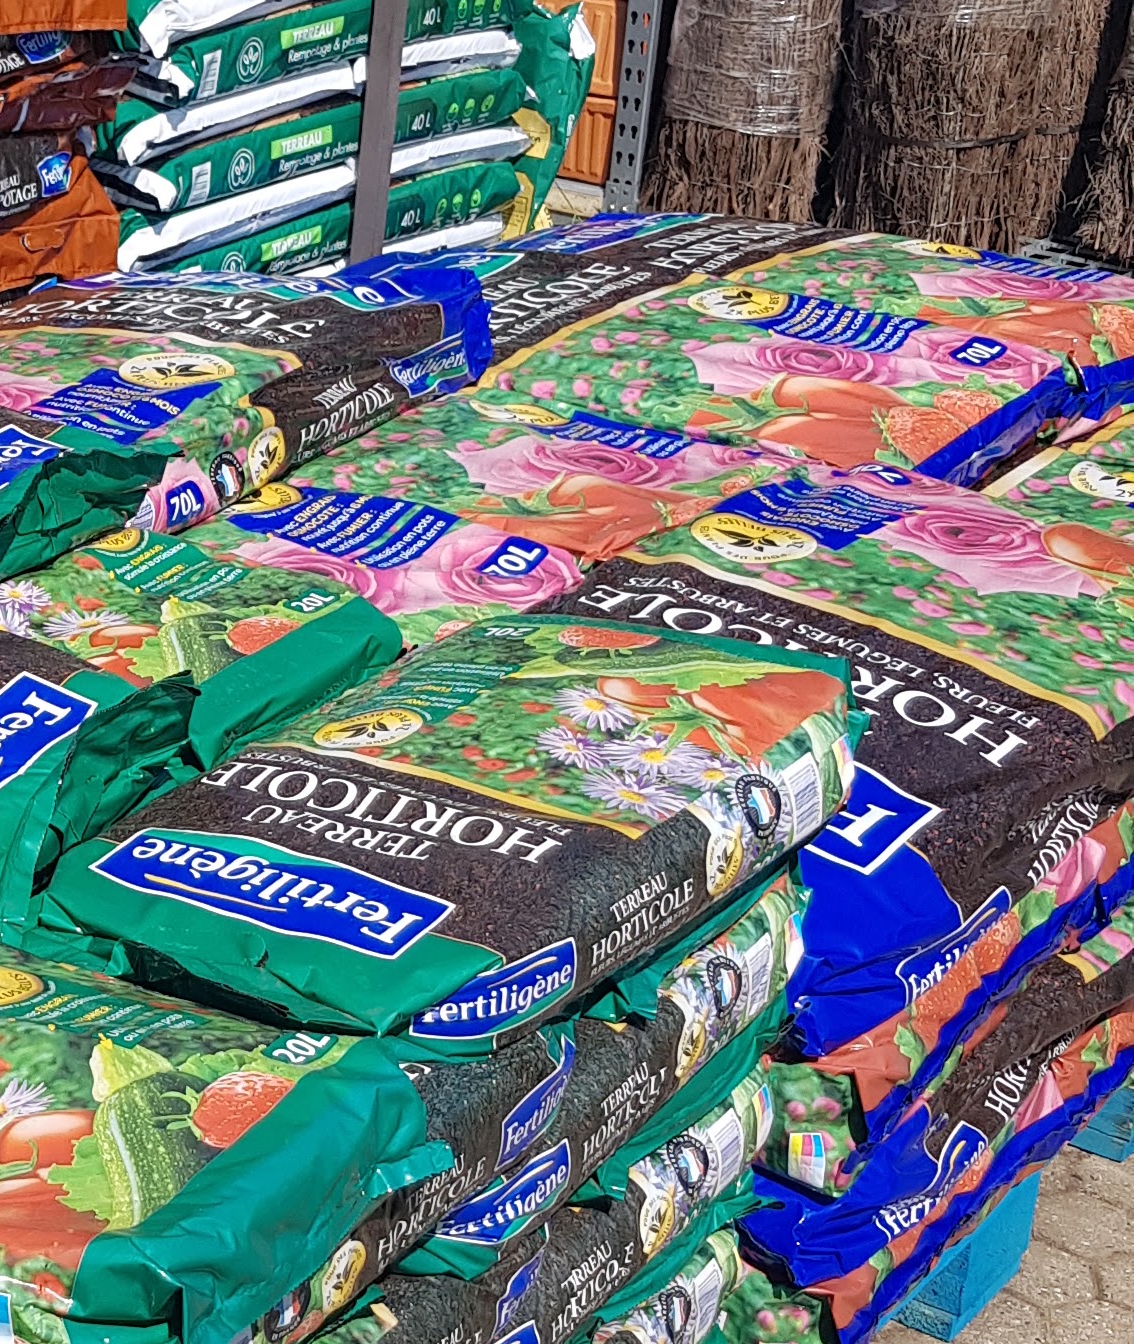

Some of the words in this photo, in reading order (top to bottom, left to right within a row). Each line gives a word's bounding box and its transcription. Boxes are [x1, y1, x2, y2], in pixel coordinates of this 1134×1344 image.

[423, 8, 436, 26] 40
[293, 23, 334, 45] TERREAU
[412, 112, 425, 131] 40
[281, 131, 323, 154] TERREAU
[331, 141, 358, 164] plantes
[401, 209, 414, 228] 40
[957, 343, 1002, 367] 70L
[298, 382, 395, 454] HORTICOLE
[170, 488, 203, 524] 70L
[367, 502, 405, 533] continue
[415, 514, 435, 535] pots
[425, 520, 447, 541] terre
[486, 544, 541, 578] 70L
[301, 591, 335, 613] 20L
[623, 575, 757, 618] ARBUSTES
[486, 627, 533, 638] 20L
[751, 611, 793, 634] ET
[793, 623, 928, 679] LÉGUMES
[932, 671, 1041, 730] FLEURS,
[201, 760, 563, 864] HORTICOLE
[244, 804, 441, 862] TERREAU
[132, 837, 423, 945] Fertiligène
[610, 871, 668, 923] TERREAU
[591, 878, 695, 966] HORTICOLE
[272, 1032, 330, 1065] 20L
[377, 1156, 486, 1259] HORTICOLE
